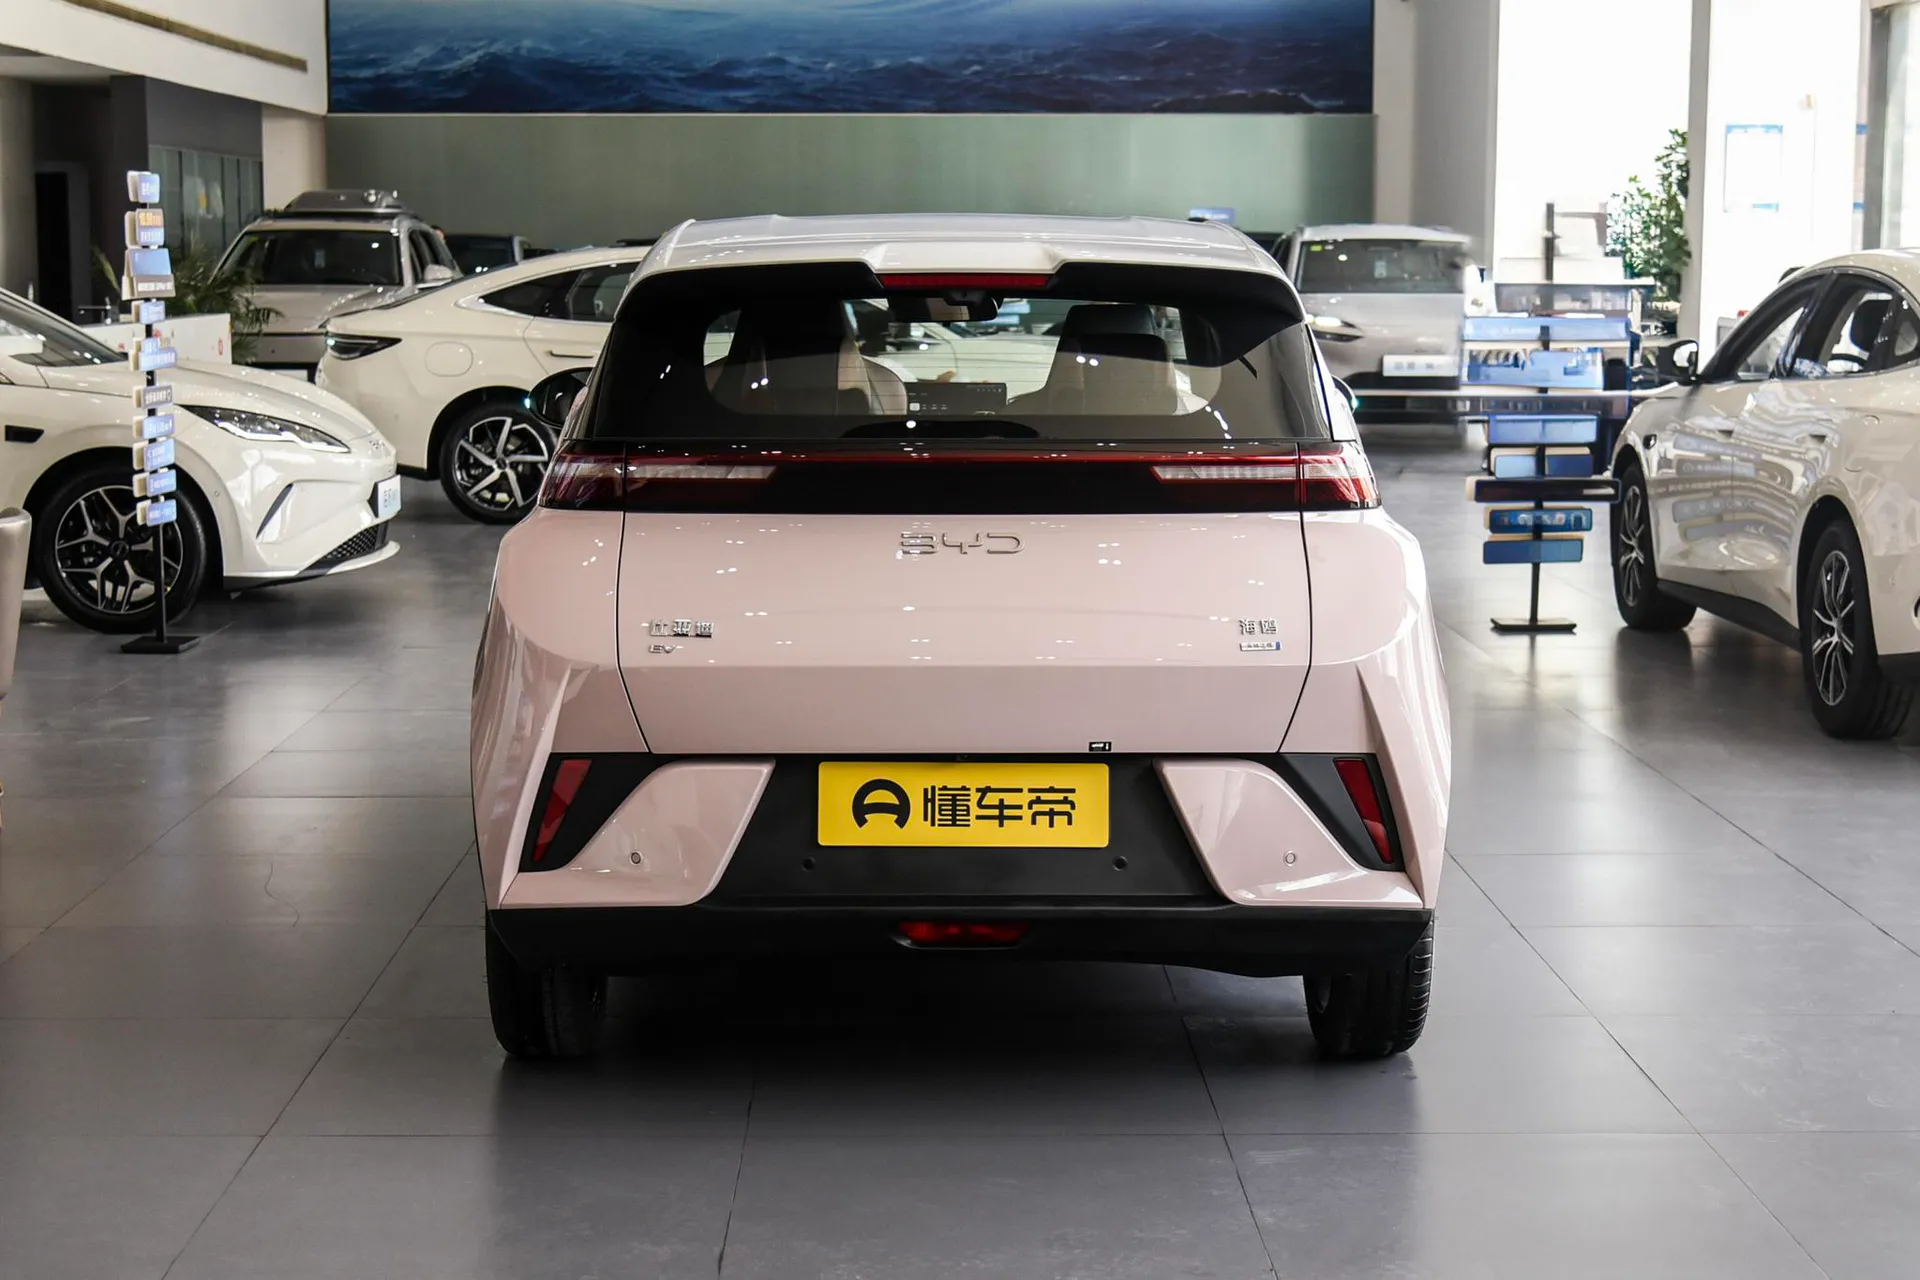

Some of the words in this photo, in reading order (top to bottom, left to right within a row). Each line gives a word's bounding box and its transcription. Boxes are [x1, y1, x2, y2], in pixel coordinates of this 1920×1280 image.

[900, 532, 1023, 554] BYD
[648, 644, 677, 654] EV
[923, 785, 1076, 828] 懂车帝
